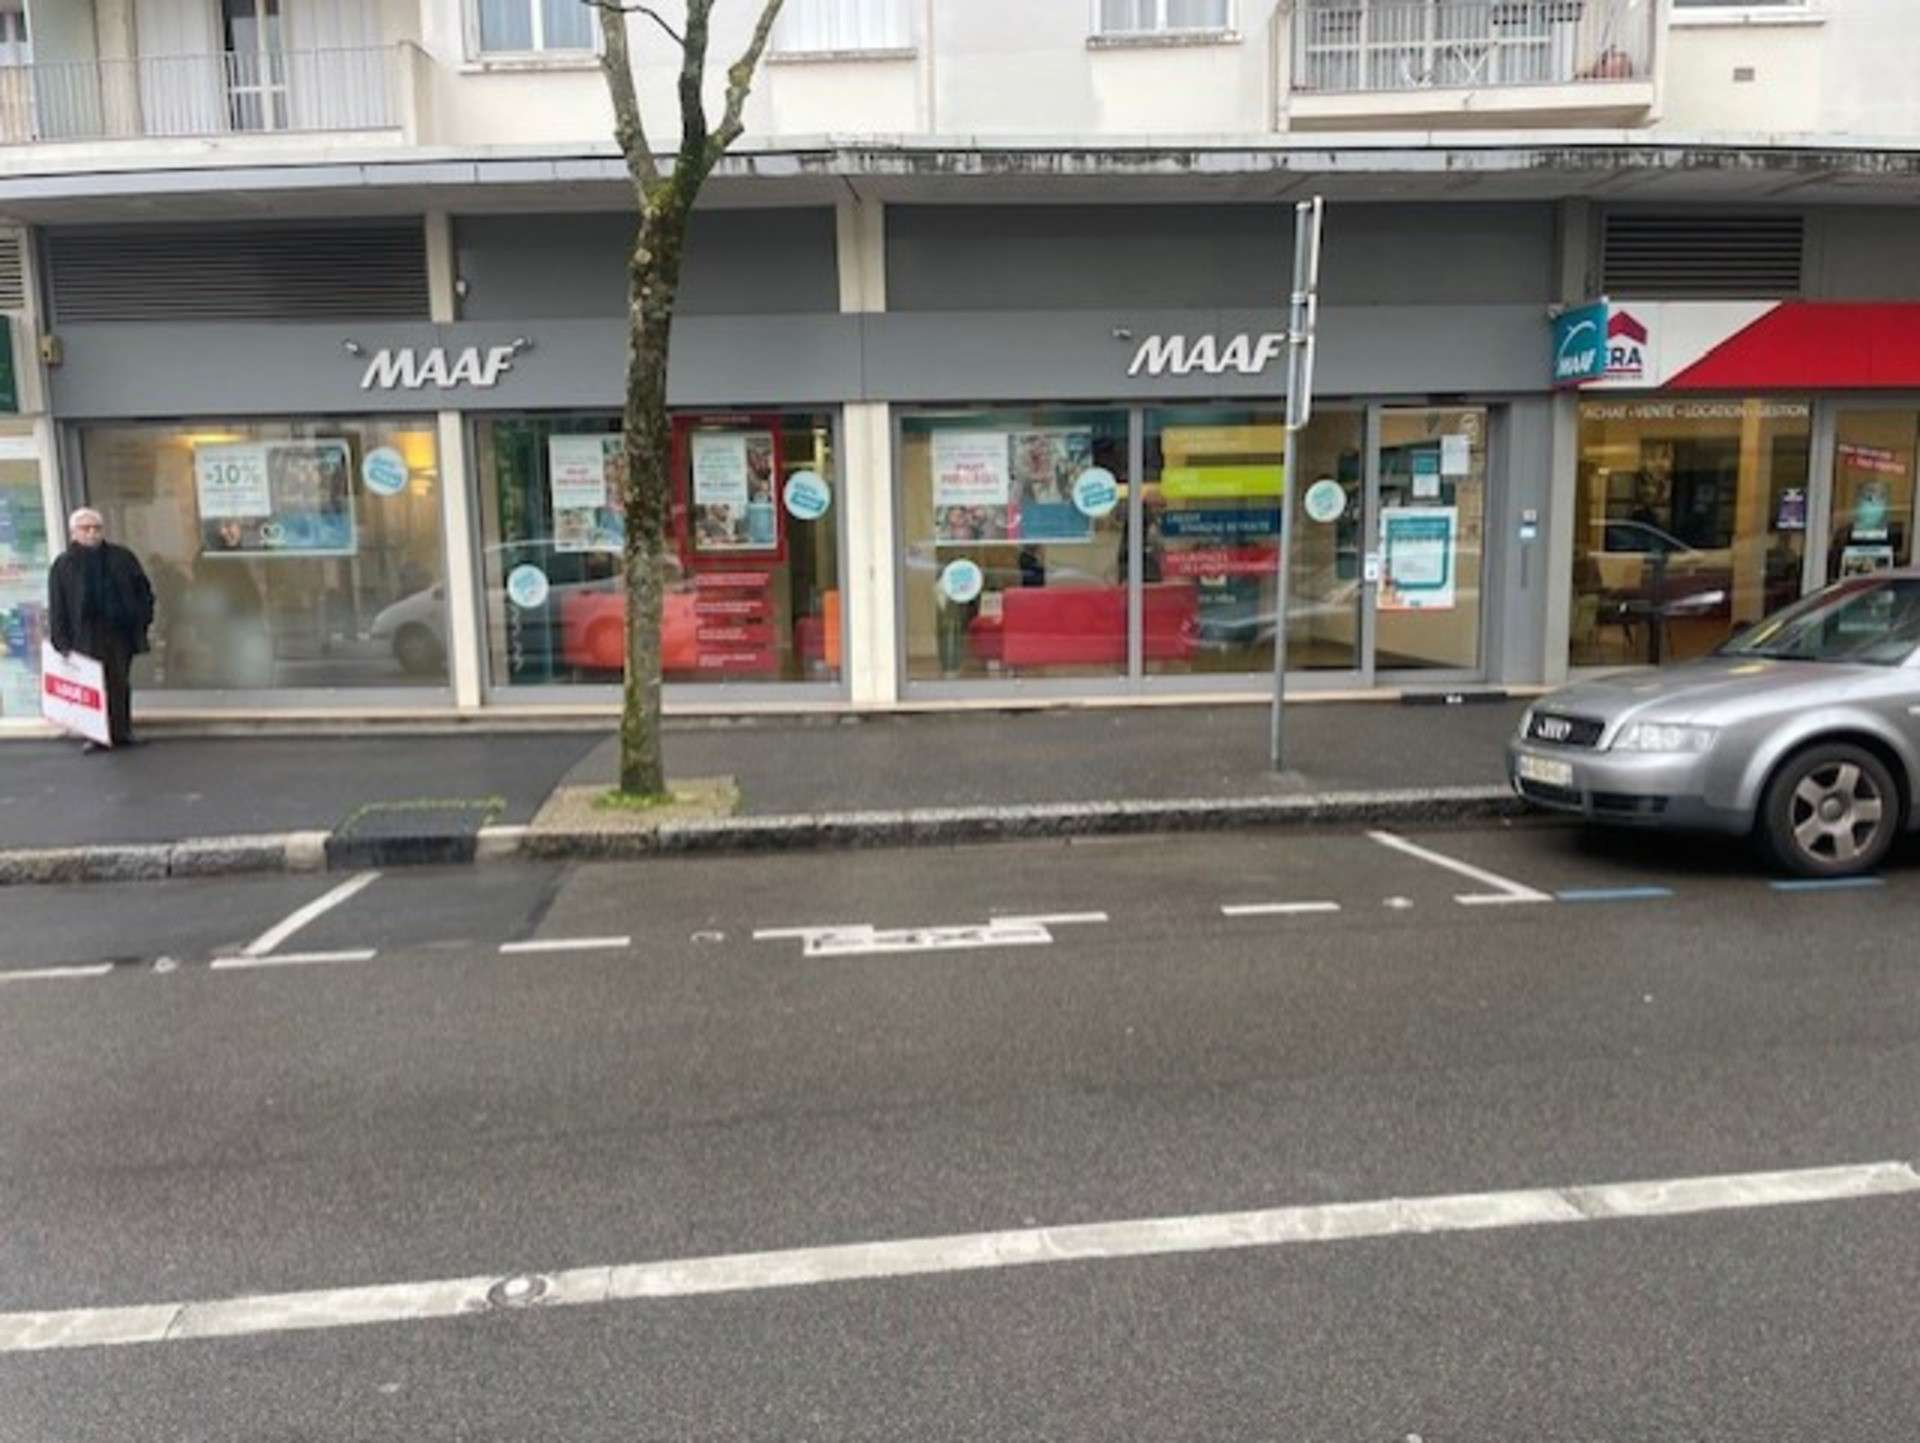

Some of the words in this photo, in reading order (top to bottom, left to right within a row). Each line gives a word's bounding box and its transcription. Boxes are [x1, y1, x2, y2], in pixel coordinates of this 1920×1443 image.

[1127, 333, 1285, 376] MAAF
[1556, 348, 1597, 377] MAAF
[1605, 346, 1643, 367] RA
[360, 346, 514, 389] MAAF
[1634, 404, 1675, 418] VENTE
[1685, 403, 1744, 417] LOCATION
[1758, 403, 1809, 417] GESTION
[204, 464, 260, 485] -10%
